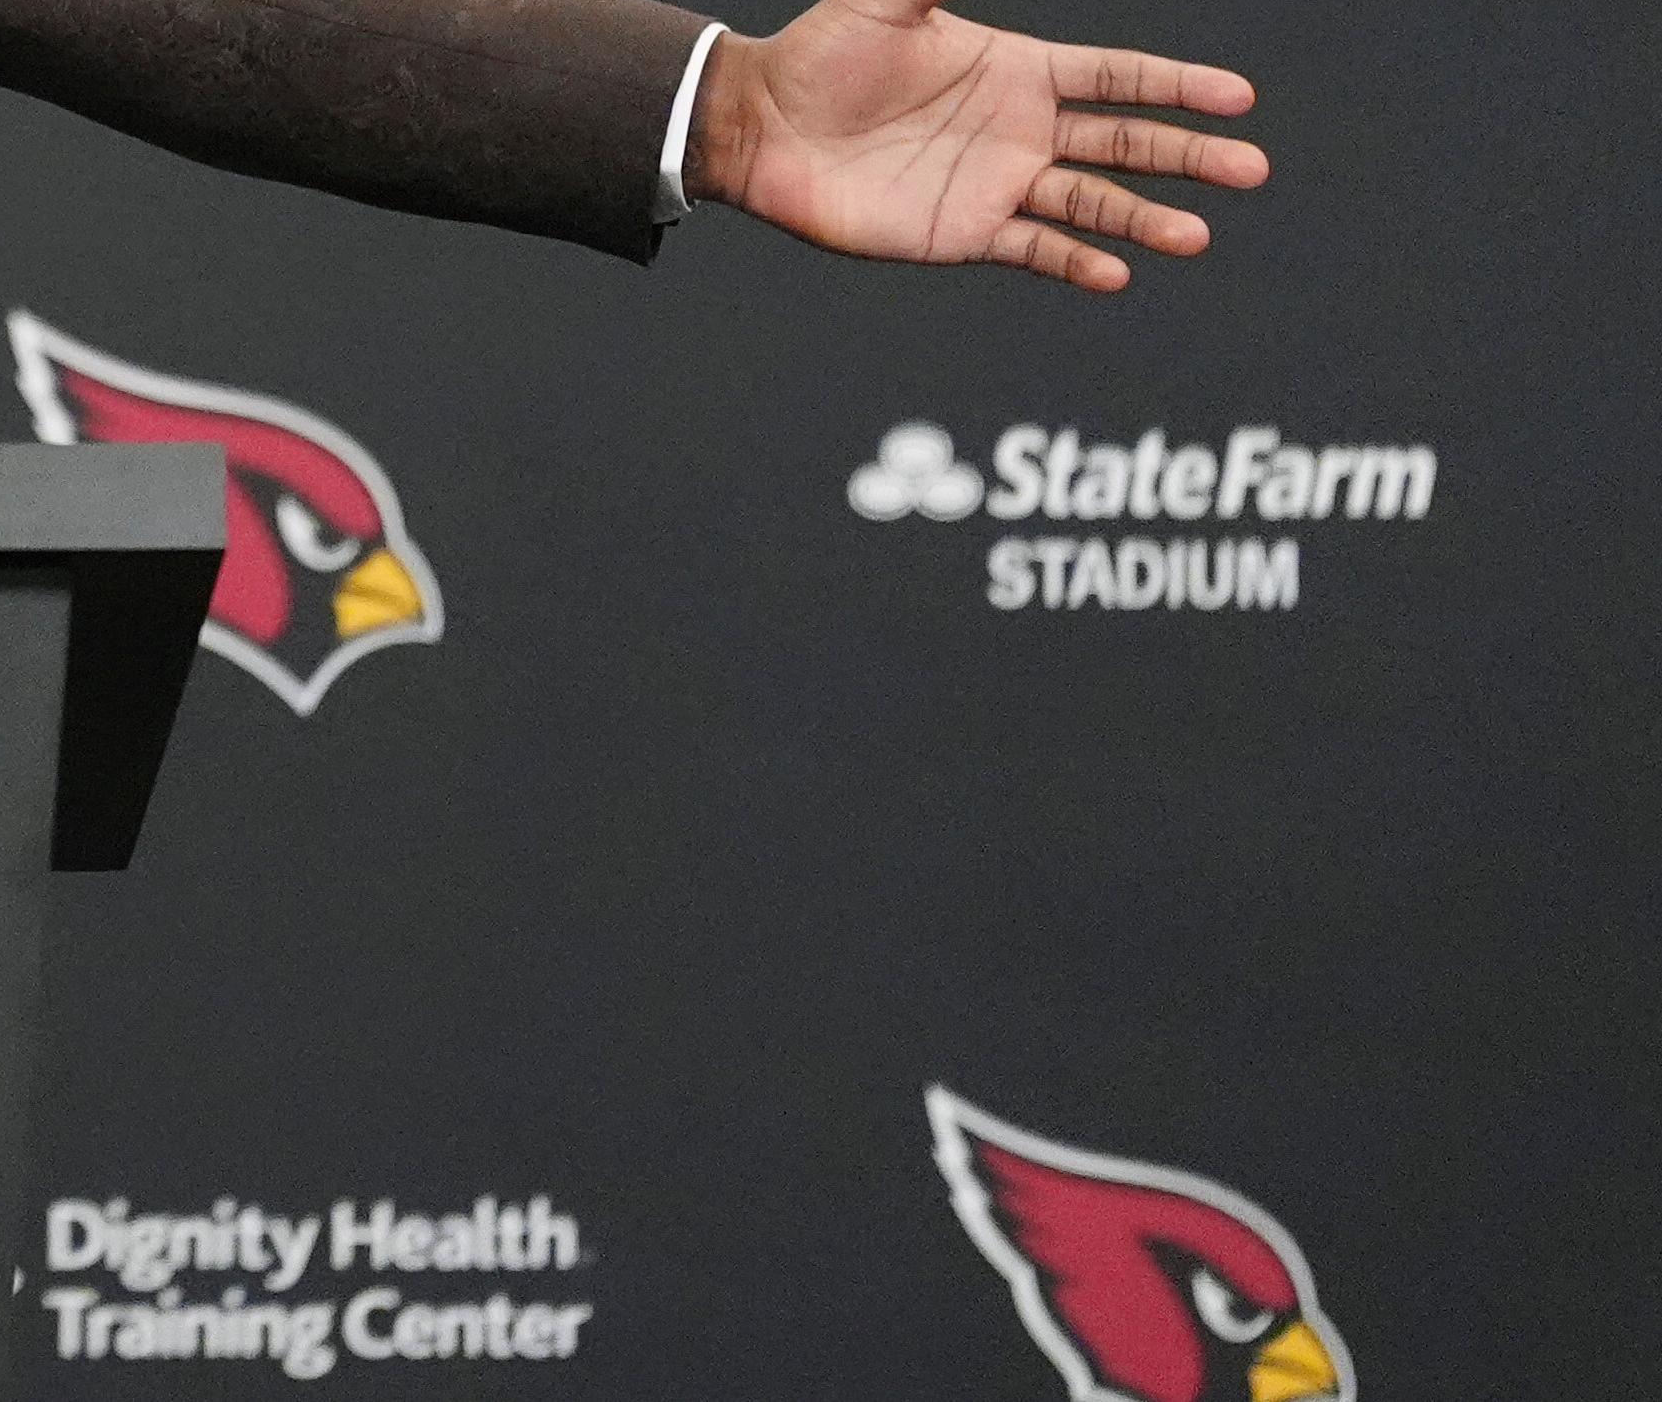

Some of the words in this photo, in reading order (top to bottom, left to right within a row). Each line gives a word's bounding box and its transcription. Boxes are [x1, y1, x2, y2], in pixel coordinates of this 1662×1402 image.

[987, 537, 1299, 610] STADIUM
[47, 1198, 320, 1290] Dignity
[330, 1196, 579, 1270] Health
[43, 1287, 336, 1379] Training
[342, 1288, 592, 1359] Center
